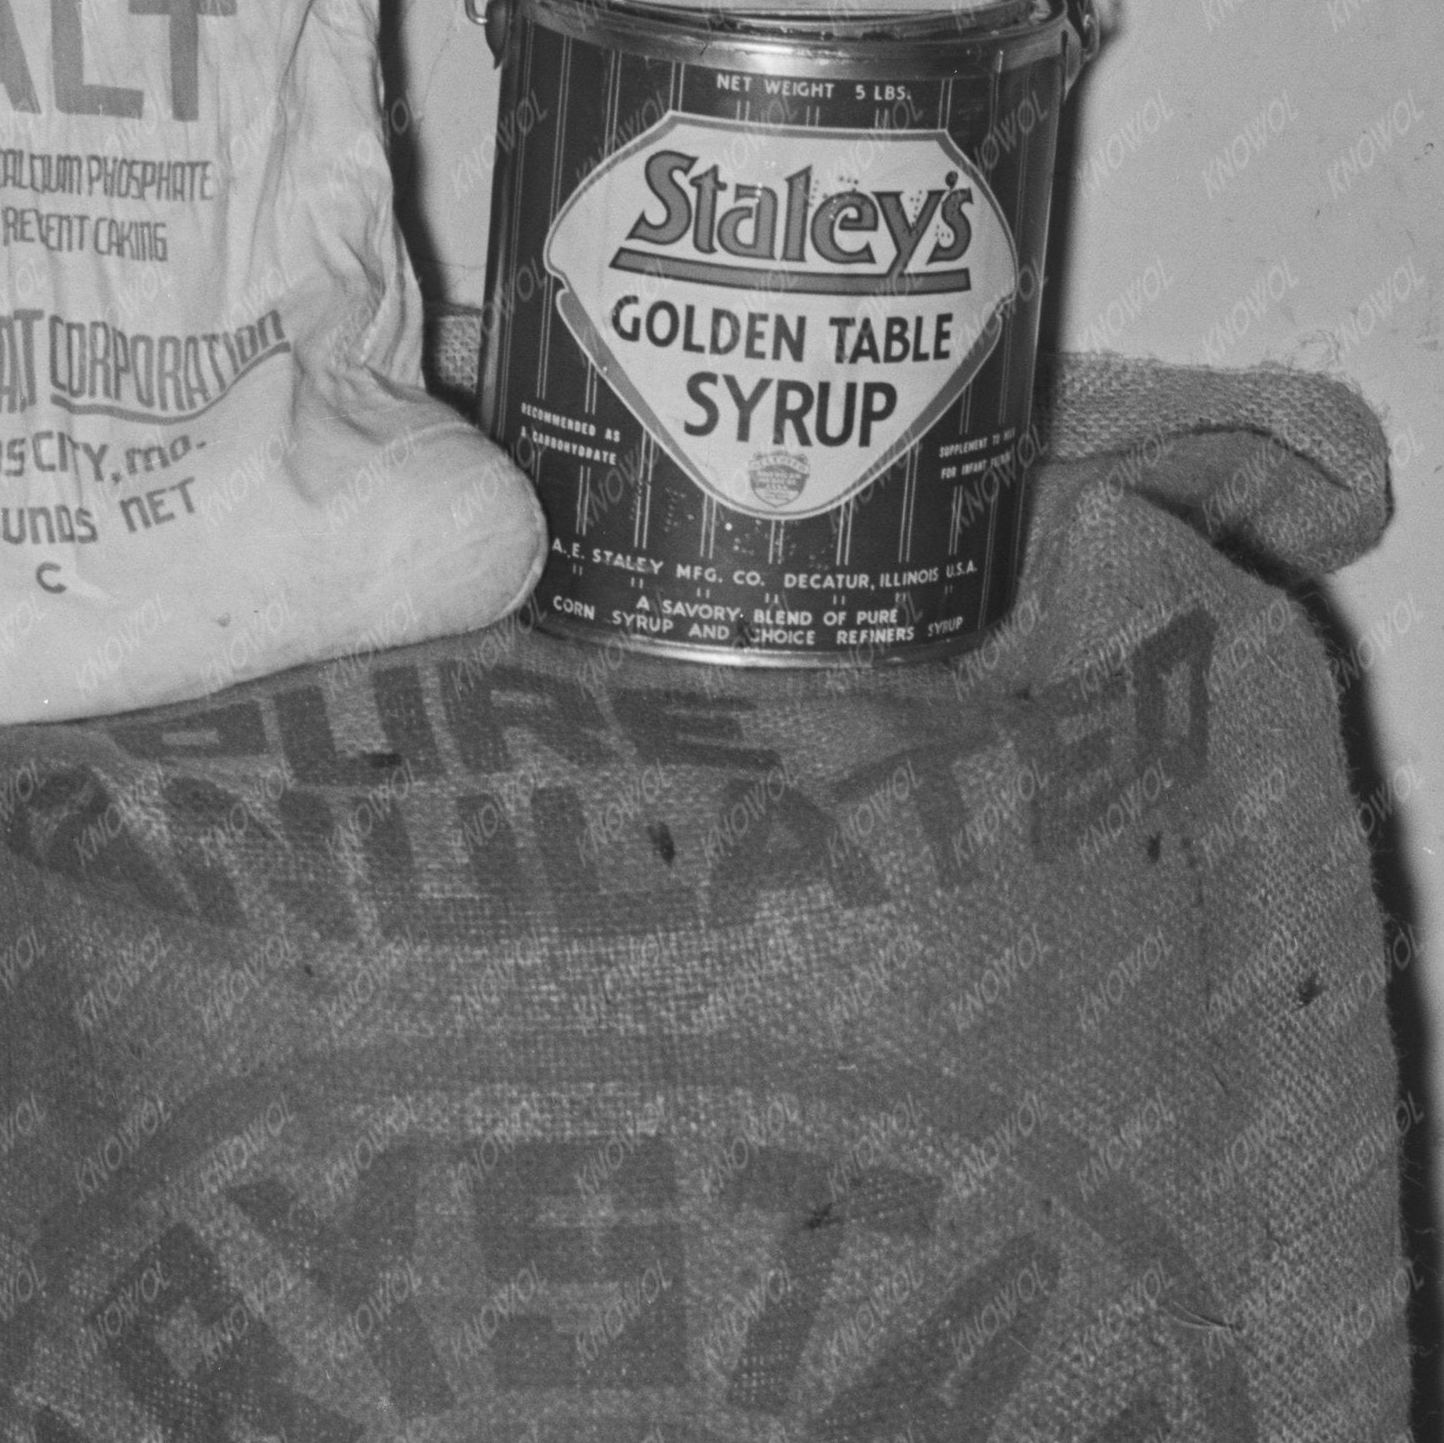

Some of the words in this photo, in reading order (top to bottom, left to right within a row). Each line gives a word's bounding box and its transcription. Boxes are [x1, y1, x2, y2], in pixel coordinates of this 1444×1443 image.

[716, 73, 753, 92] NET
[764, 79, 835, 98] WEIGHT
[855, 84, 867, 100] 5
[874, 85, 911, 101] LBS.
[87, 154, 214, 202] PHOSPHATE
[626, 149, 973, 275] Staley's
[93, 216, 169, 262] CAKING
[610, 293, 807, 363] GOLDEN
[829, 312, 955, 364] TABLE
[48, 309, 287, 412] CORPORATION
[684, 369, 898, 448] SYRUP
[604, 428, 621, 443] AS
[118, 476, 196, 534] NET
[591, 547, 665, 576] STALEY
[675, 563, 724, 584] MFG.
[732, 570, 766, 587] CO.
[783, 573, 876, 592] DECATUR,
[879, 567, 940, 589] ILLINOIS
[552, 594, 596, 621] CORN
[612, 610, 674, 634] SYRUP
[688, 623, 730, 641] AND
[836, 626, 915, 646] REFINERS
[635, 594, 651, 611] A
[661, 599, 742, 622] SAVORY
[753, 608, 813, 626] BLEND
[823, 610, 848, 627] OF
[856, 607, 899, 626] PURE
